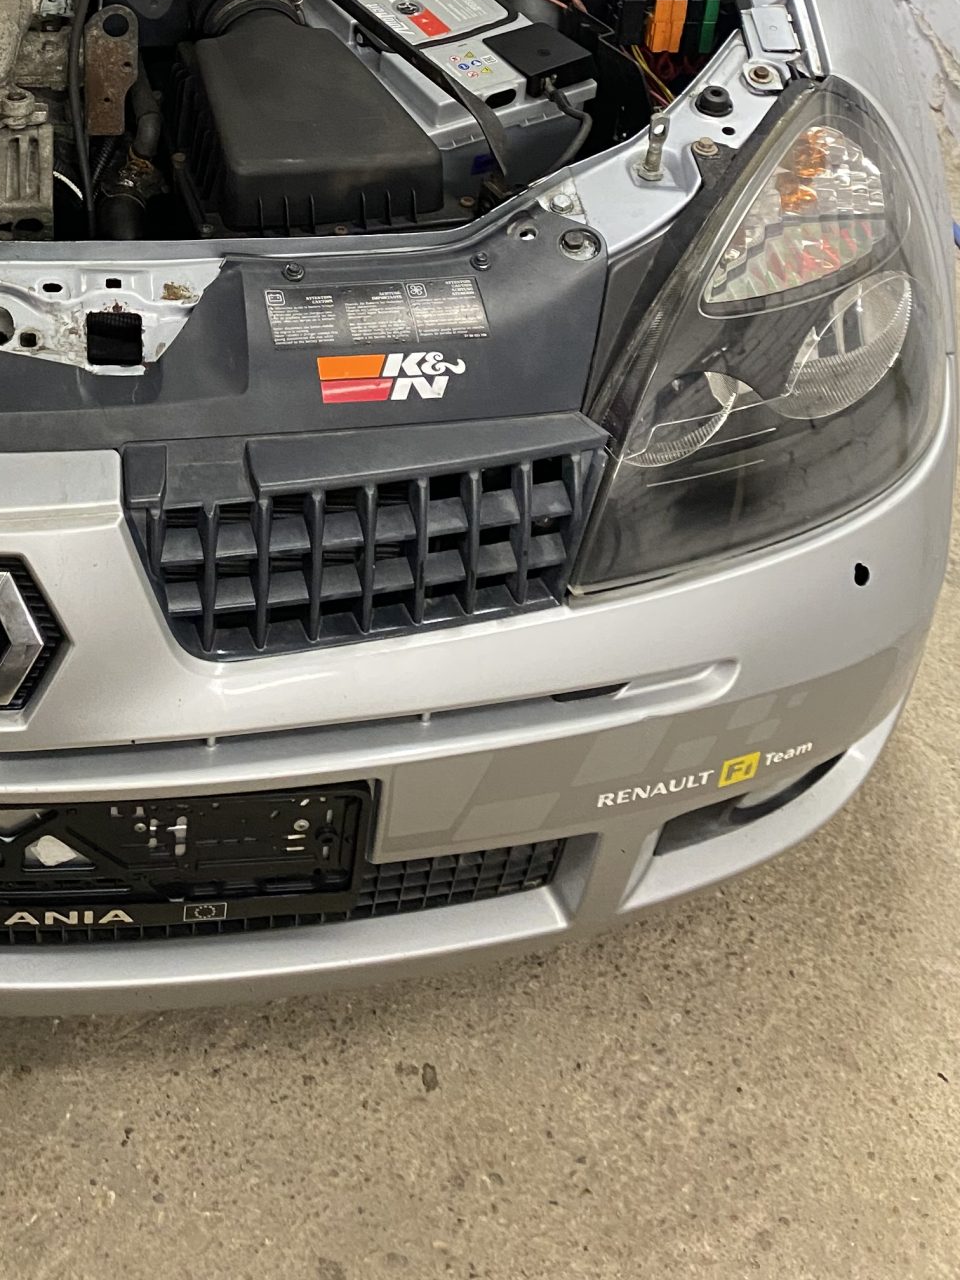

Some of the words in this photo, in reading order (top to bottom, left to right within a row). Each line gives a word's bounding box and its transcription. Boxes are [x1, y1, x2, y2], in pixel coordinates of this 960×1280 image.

[597, 770, 715, 808] RENAULT
[725, 761, 753, 781] F1
[765, 742, 813, 766] Team
